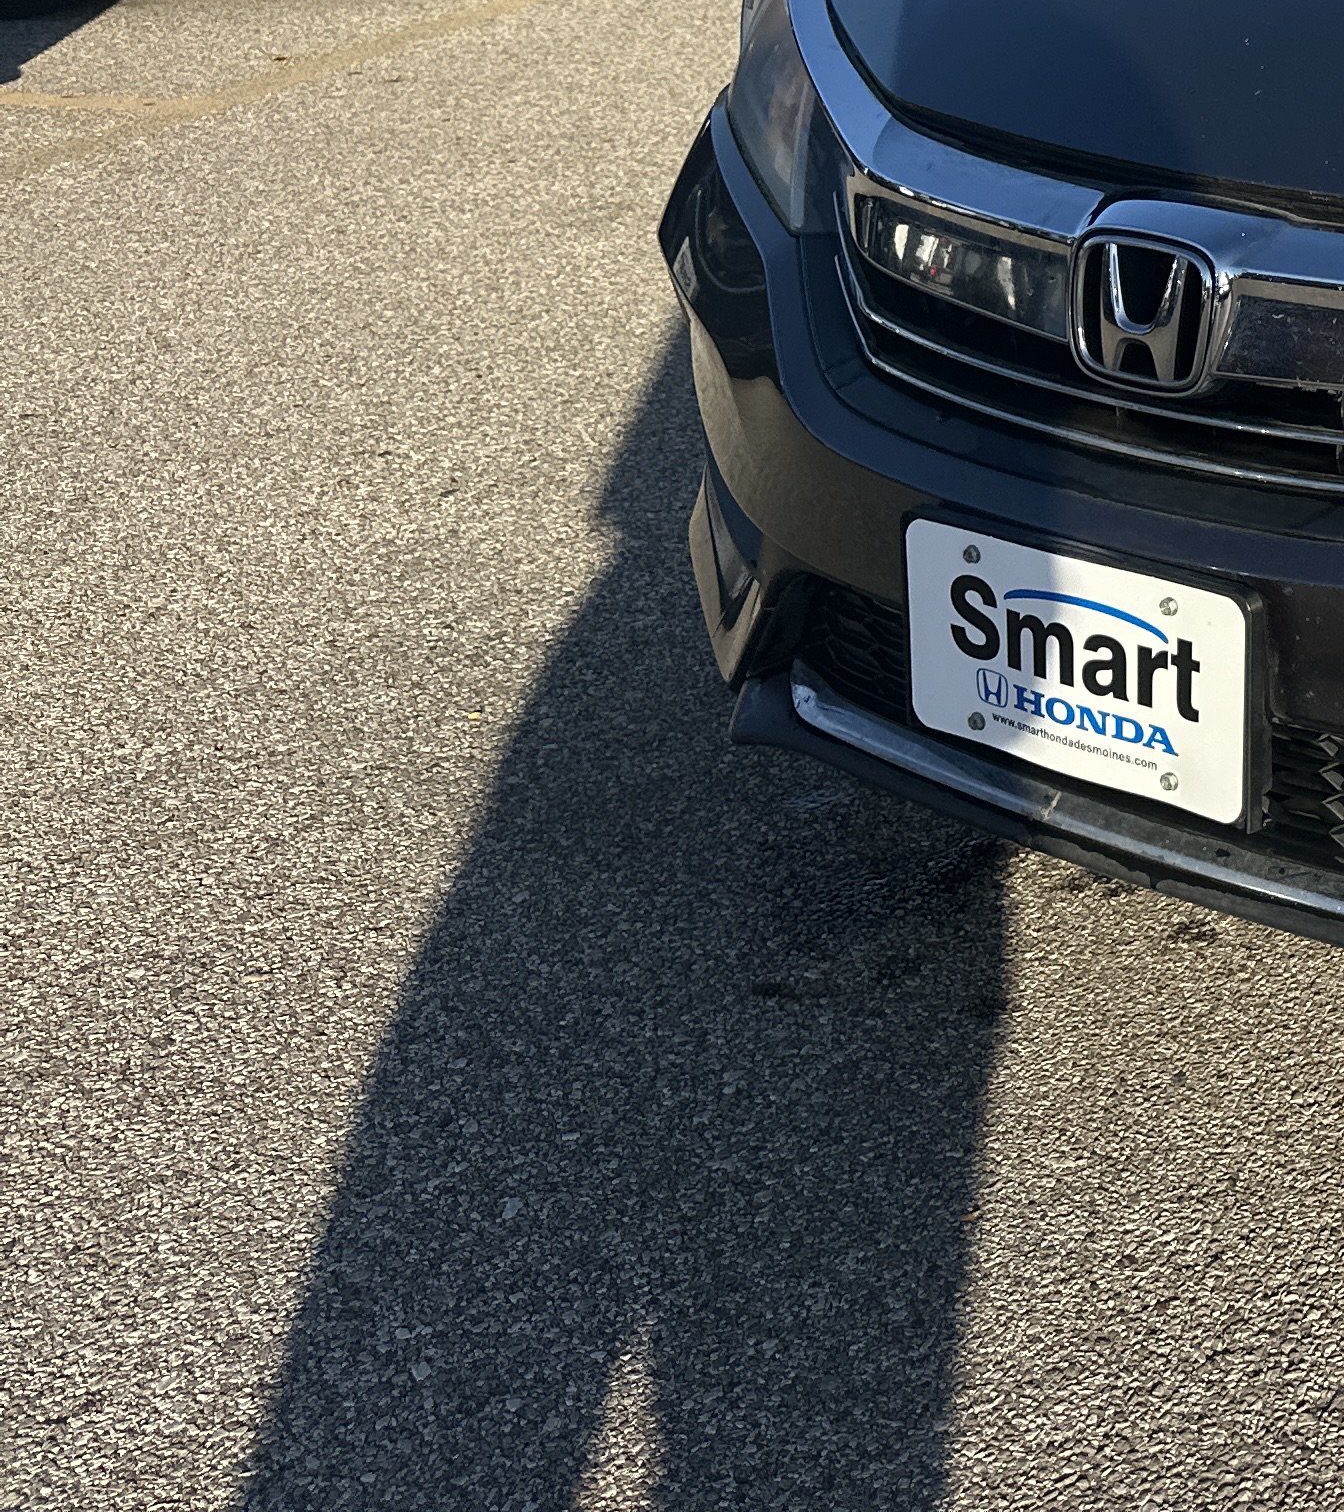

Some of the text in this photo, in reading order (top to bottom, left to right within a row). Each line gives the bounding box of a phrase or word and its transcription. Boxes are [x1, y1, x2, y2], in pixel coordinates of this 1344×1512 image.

[950, 574, 1200, 722] Smart
[992, 712, 1158, 771] www.smarthondadesmoines.com
[1013, 684, 1179, 757] HONDA
